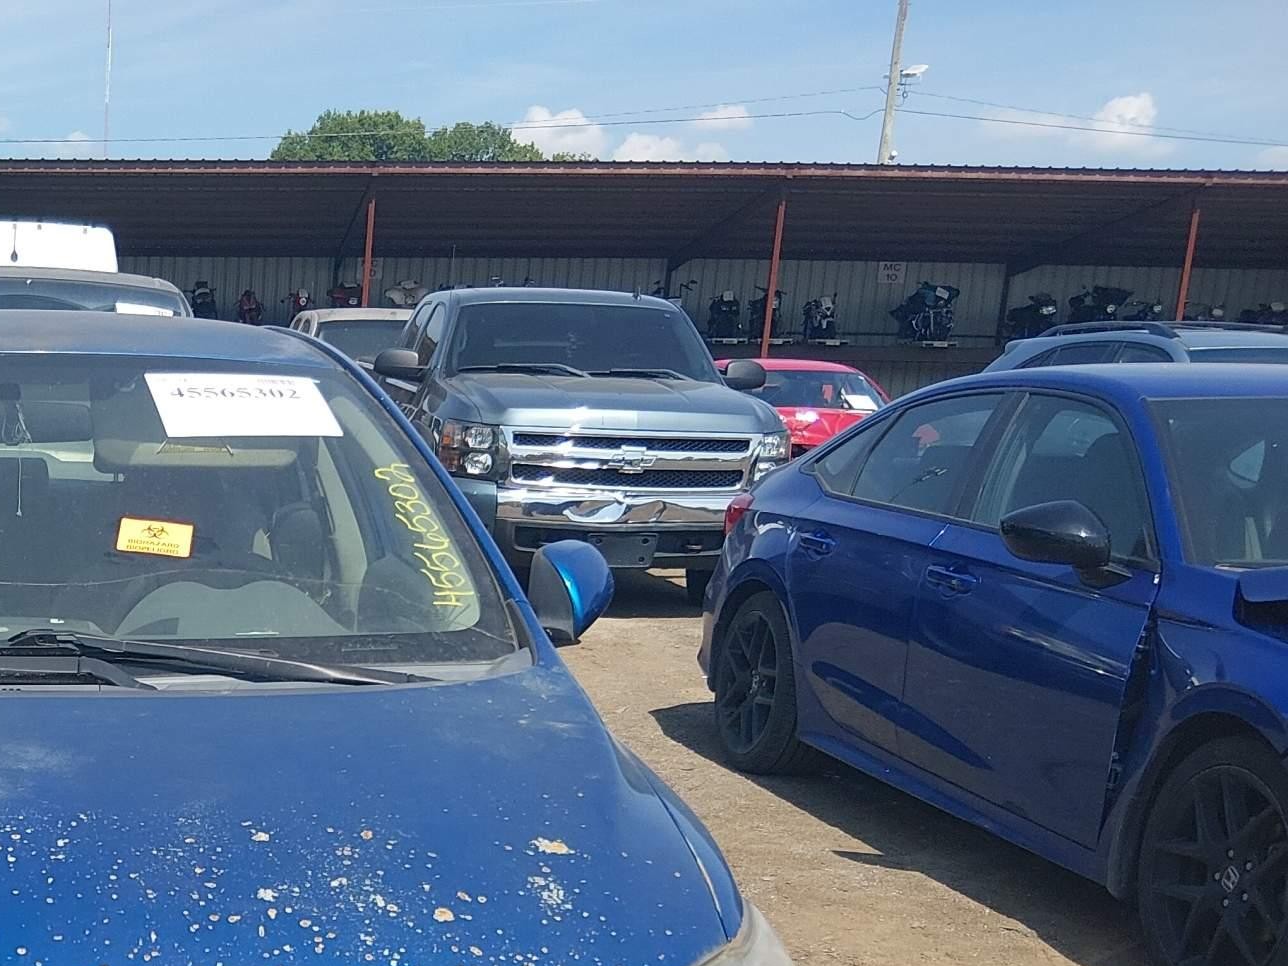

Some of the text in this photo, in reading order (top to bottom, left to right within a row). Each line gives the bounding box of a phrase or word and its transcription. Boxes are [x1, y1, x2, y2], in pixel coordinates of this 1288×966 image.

[883, 263, 902, 271] MC
[886, 273, 898, 281] 10
[170, 386, 302, 399] 45565302
[374, 463, 475, 607] 45565302
